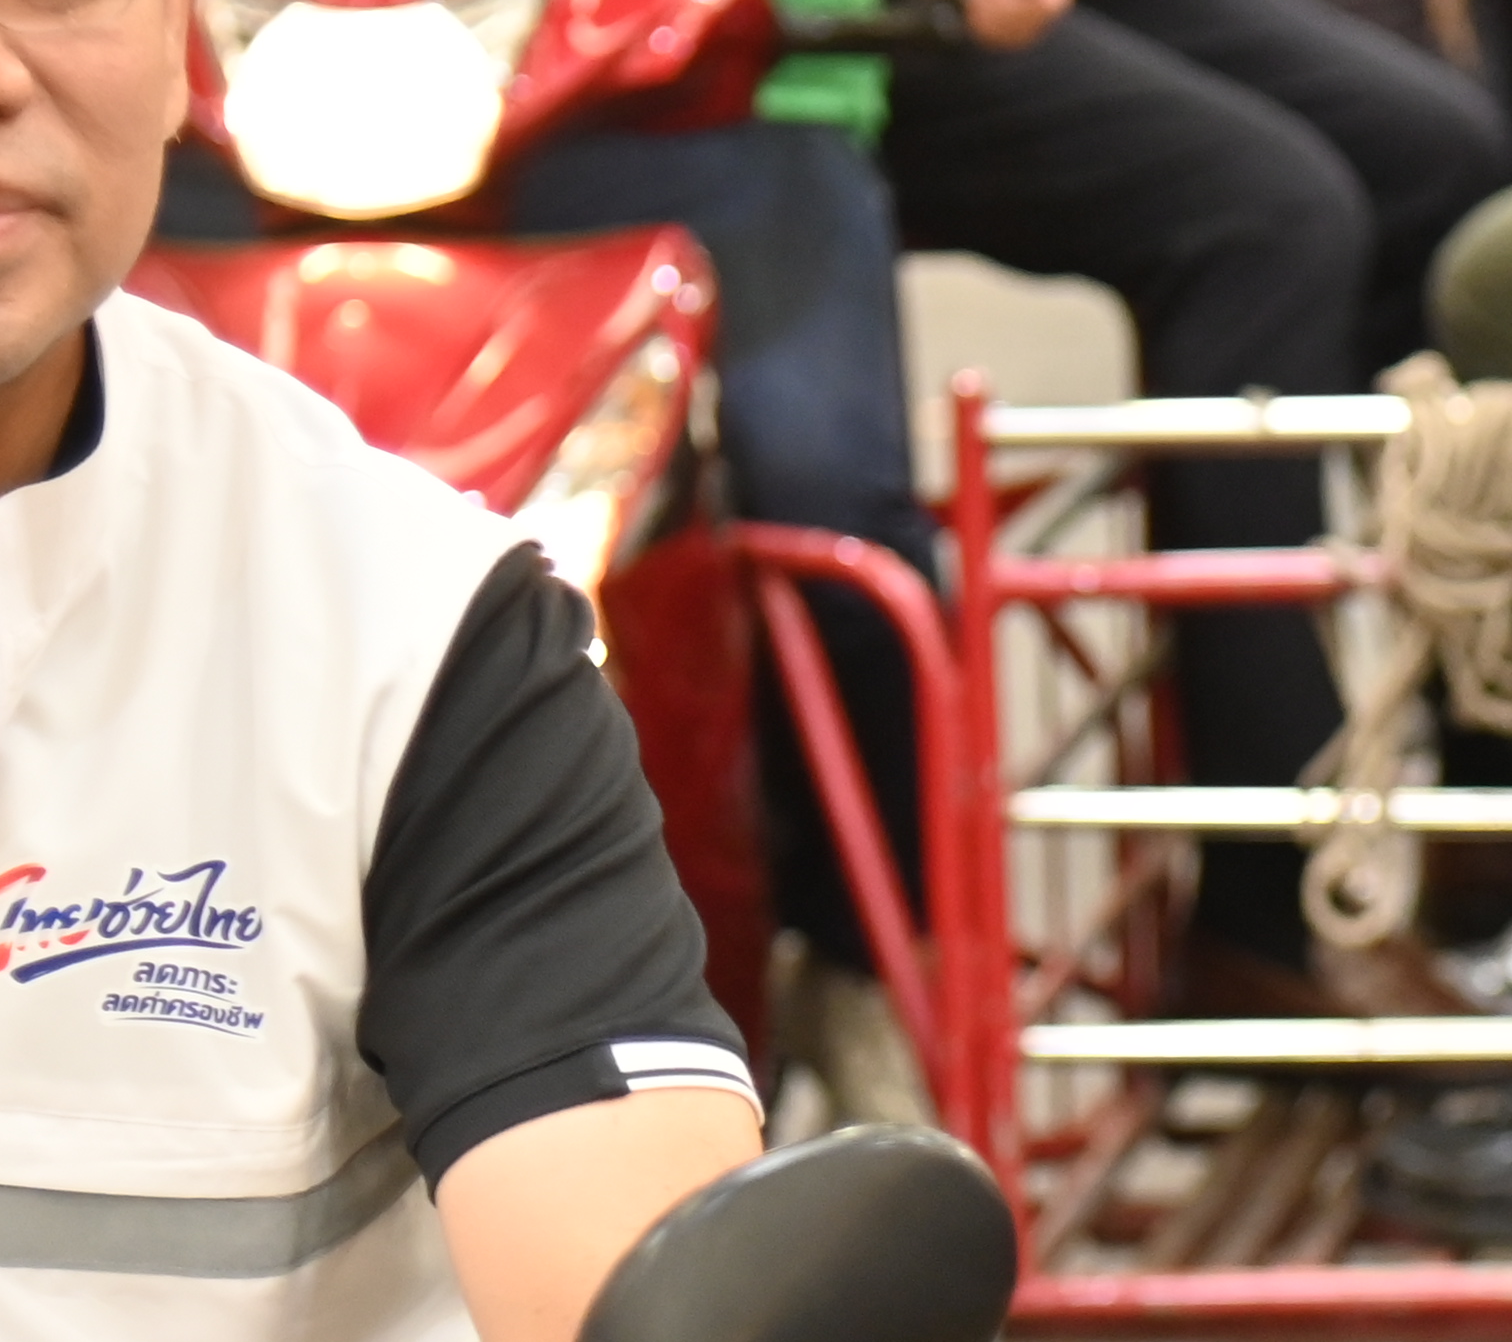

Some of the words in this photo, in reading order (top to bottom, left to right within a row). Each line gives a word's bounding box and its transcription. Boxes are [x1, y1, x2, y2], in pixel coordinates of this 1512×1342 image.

[133, 961, 239, 995] ลดภาระ
[101, 991, 264, 1029] ลดค่าครองชีพ
